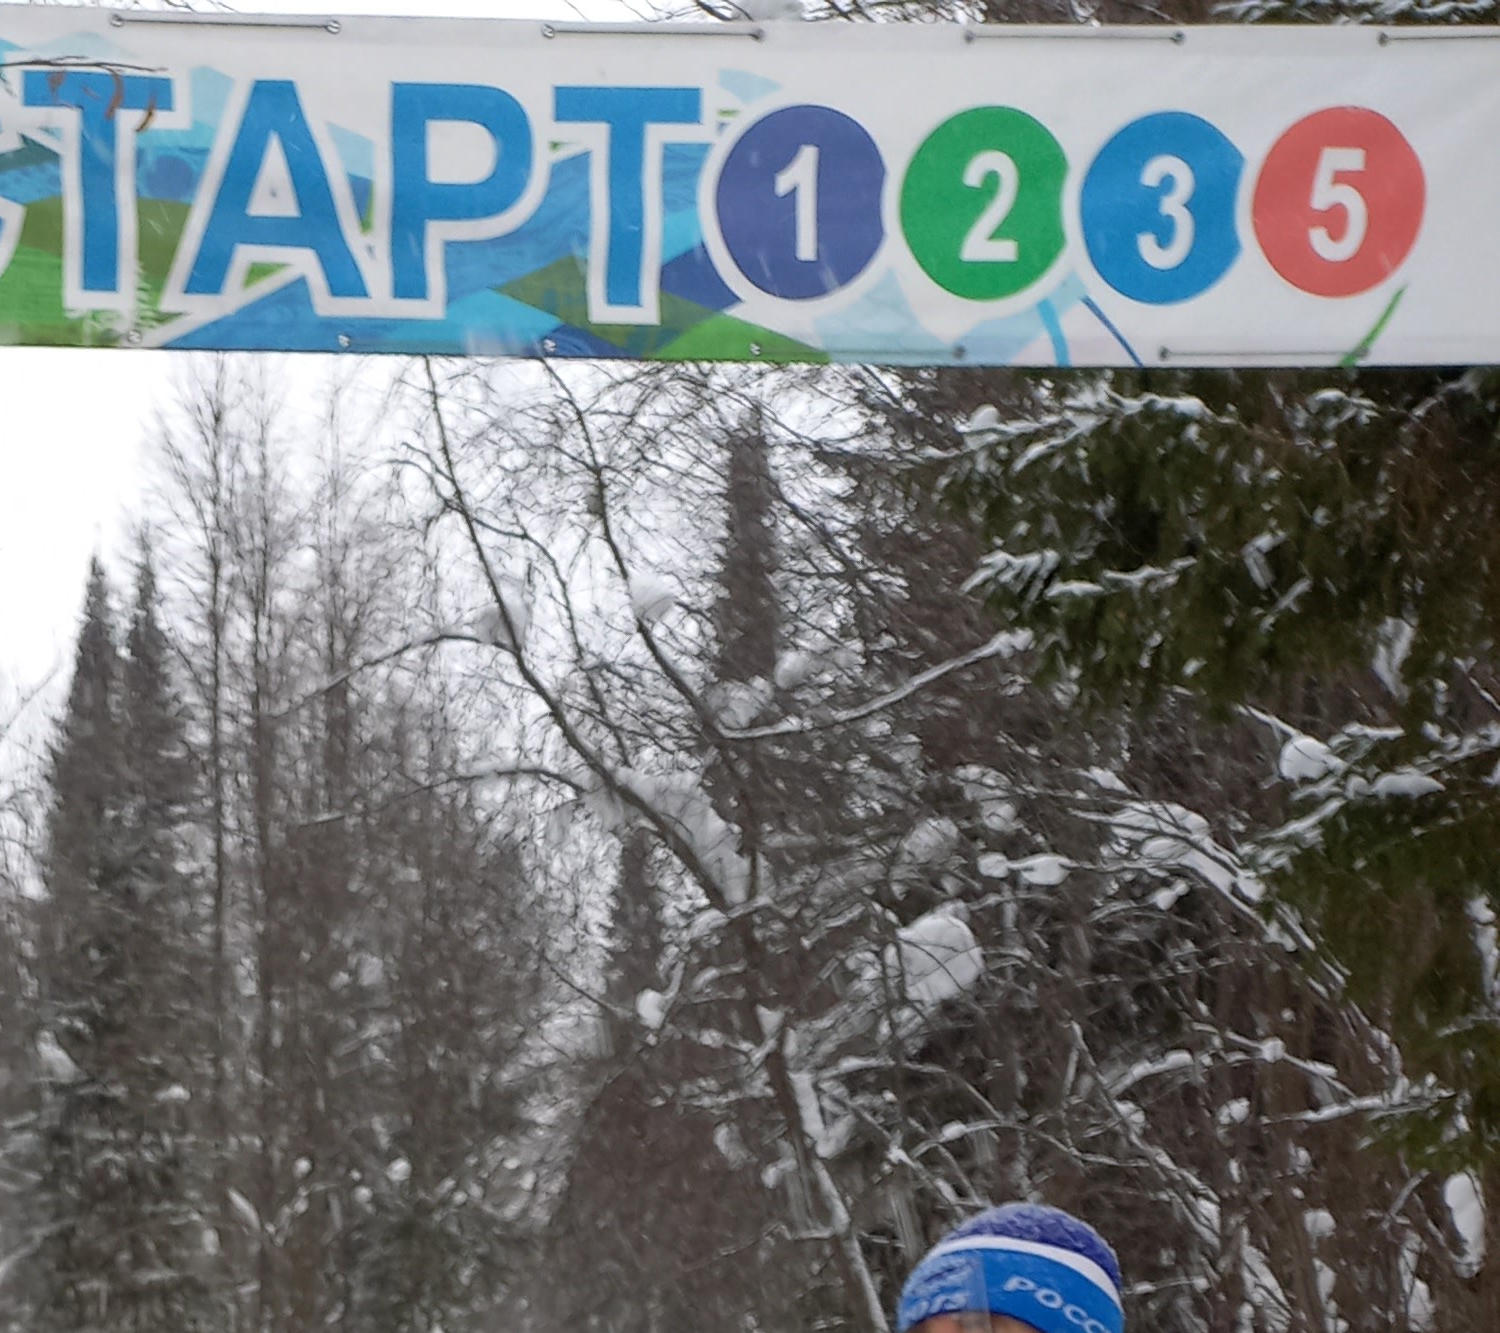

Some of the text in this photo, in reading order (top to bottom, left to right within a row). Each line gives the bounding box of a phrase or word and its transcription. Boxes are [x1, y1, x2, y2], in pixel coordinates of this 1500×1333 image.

[774, 145, 818, 261] 1
[961, 150, 1017, 261] 2
[1139, 155, 1193, 269] 3
[1308, 147, 1367, 262] 5
